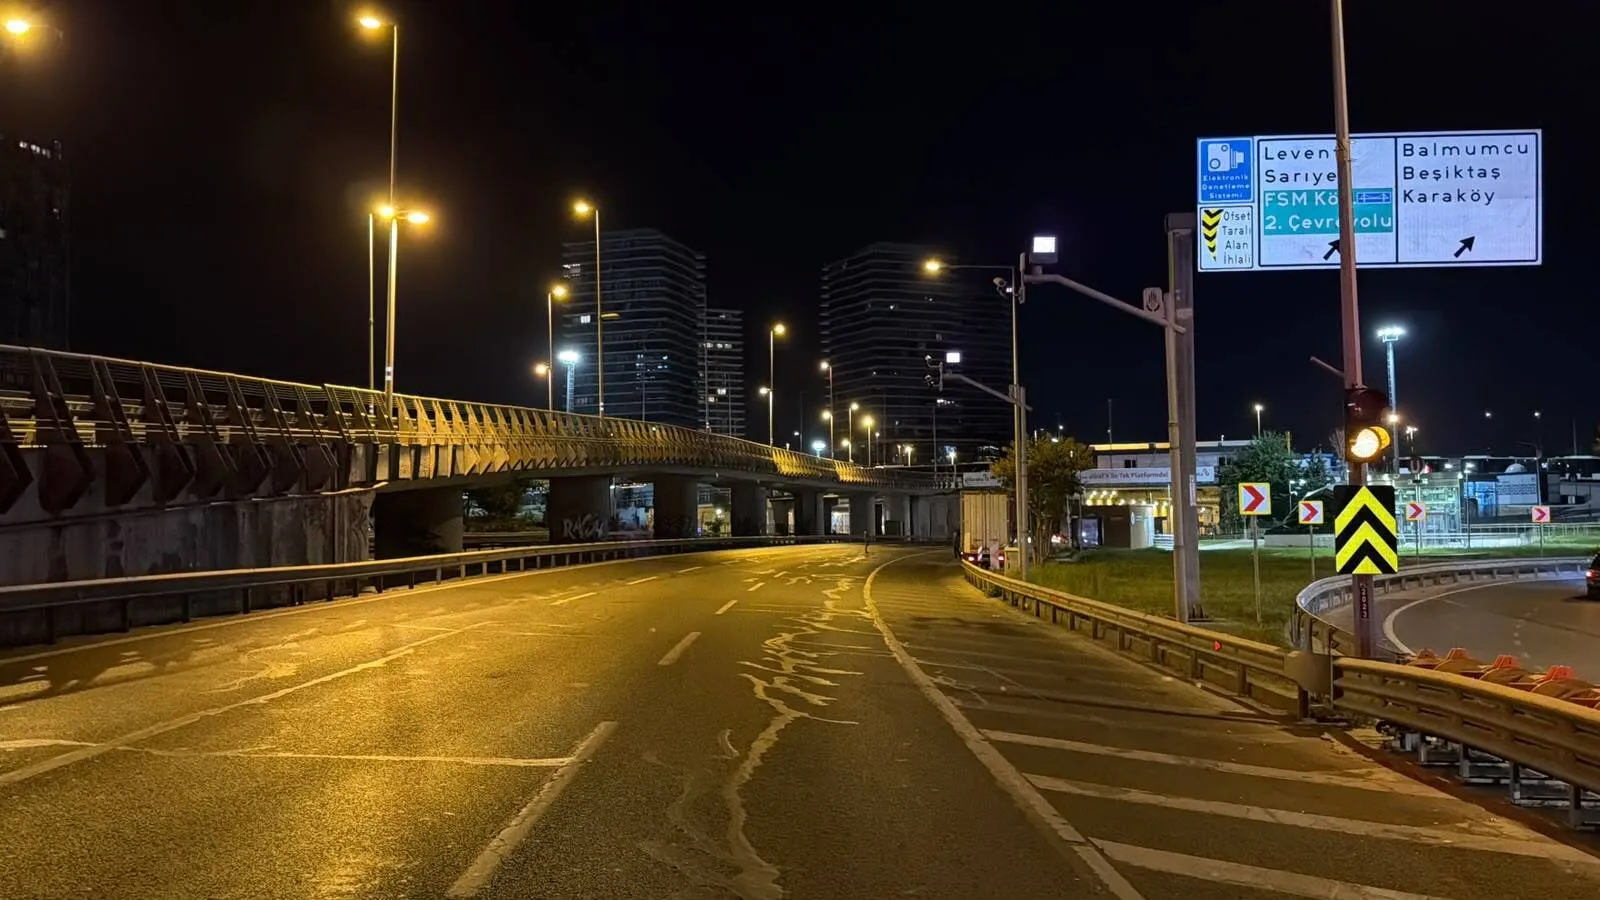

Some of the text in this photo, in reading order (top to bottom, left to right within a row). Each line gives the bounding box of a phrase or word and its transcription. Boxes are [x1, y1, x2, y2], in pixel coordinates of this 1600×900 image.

[1264, 146, 1338, 161] Leven
[1402, 142, 1528, 157] Balmumcu
[1264, 168, 1337, 186] Sarıye
[1402, 164, 1501, 181] Beşiktaş
[1264, 192, 1308, 207] FSM
[1402, 187, 1495, 206] Karaköy
[1223, 211, 1251, 221] Ofset
[1264, 215, 1282, 231] 2.
[1225, 240, 1248, 250] Alan
